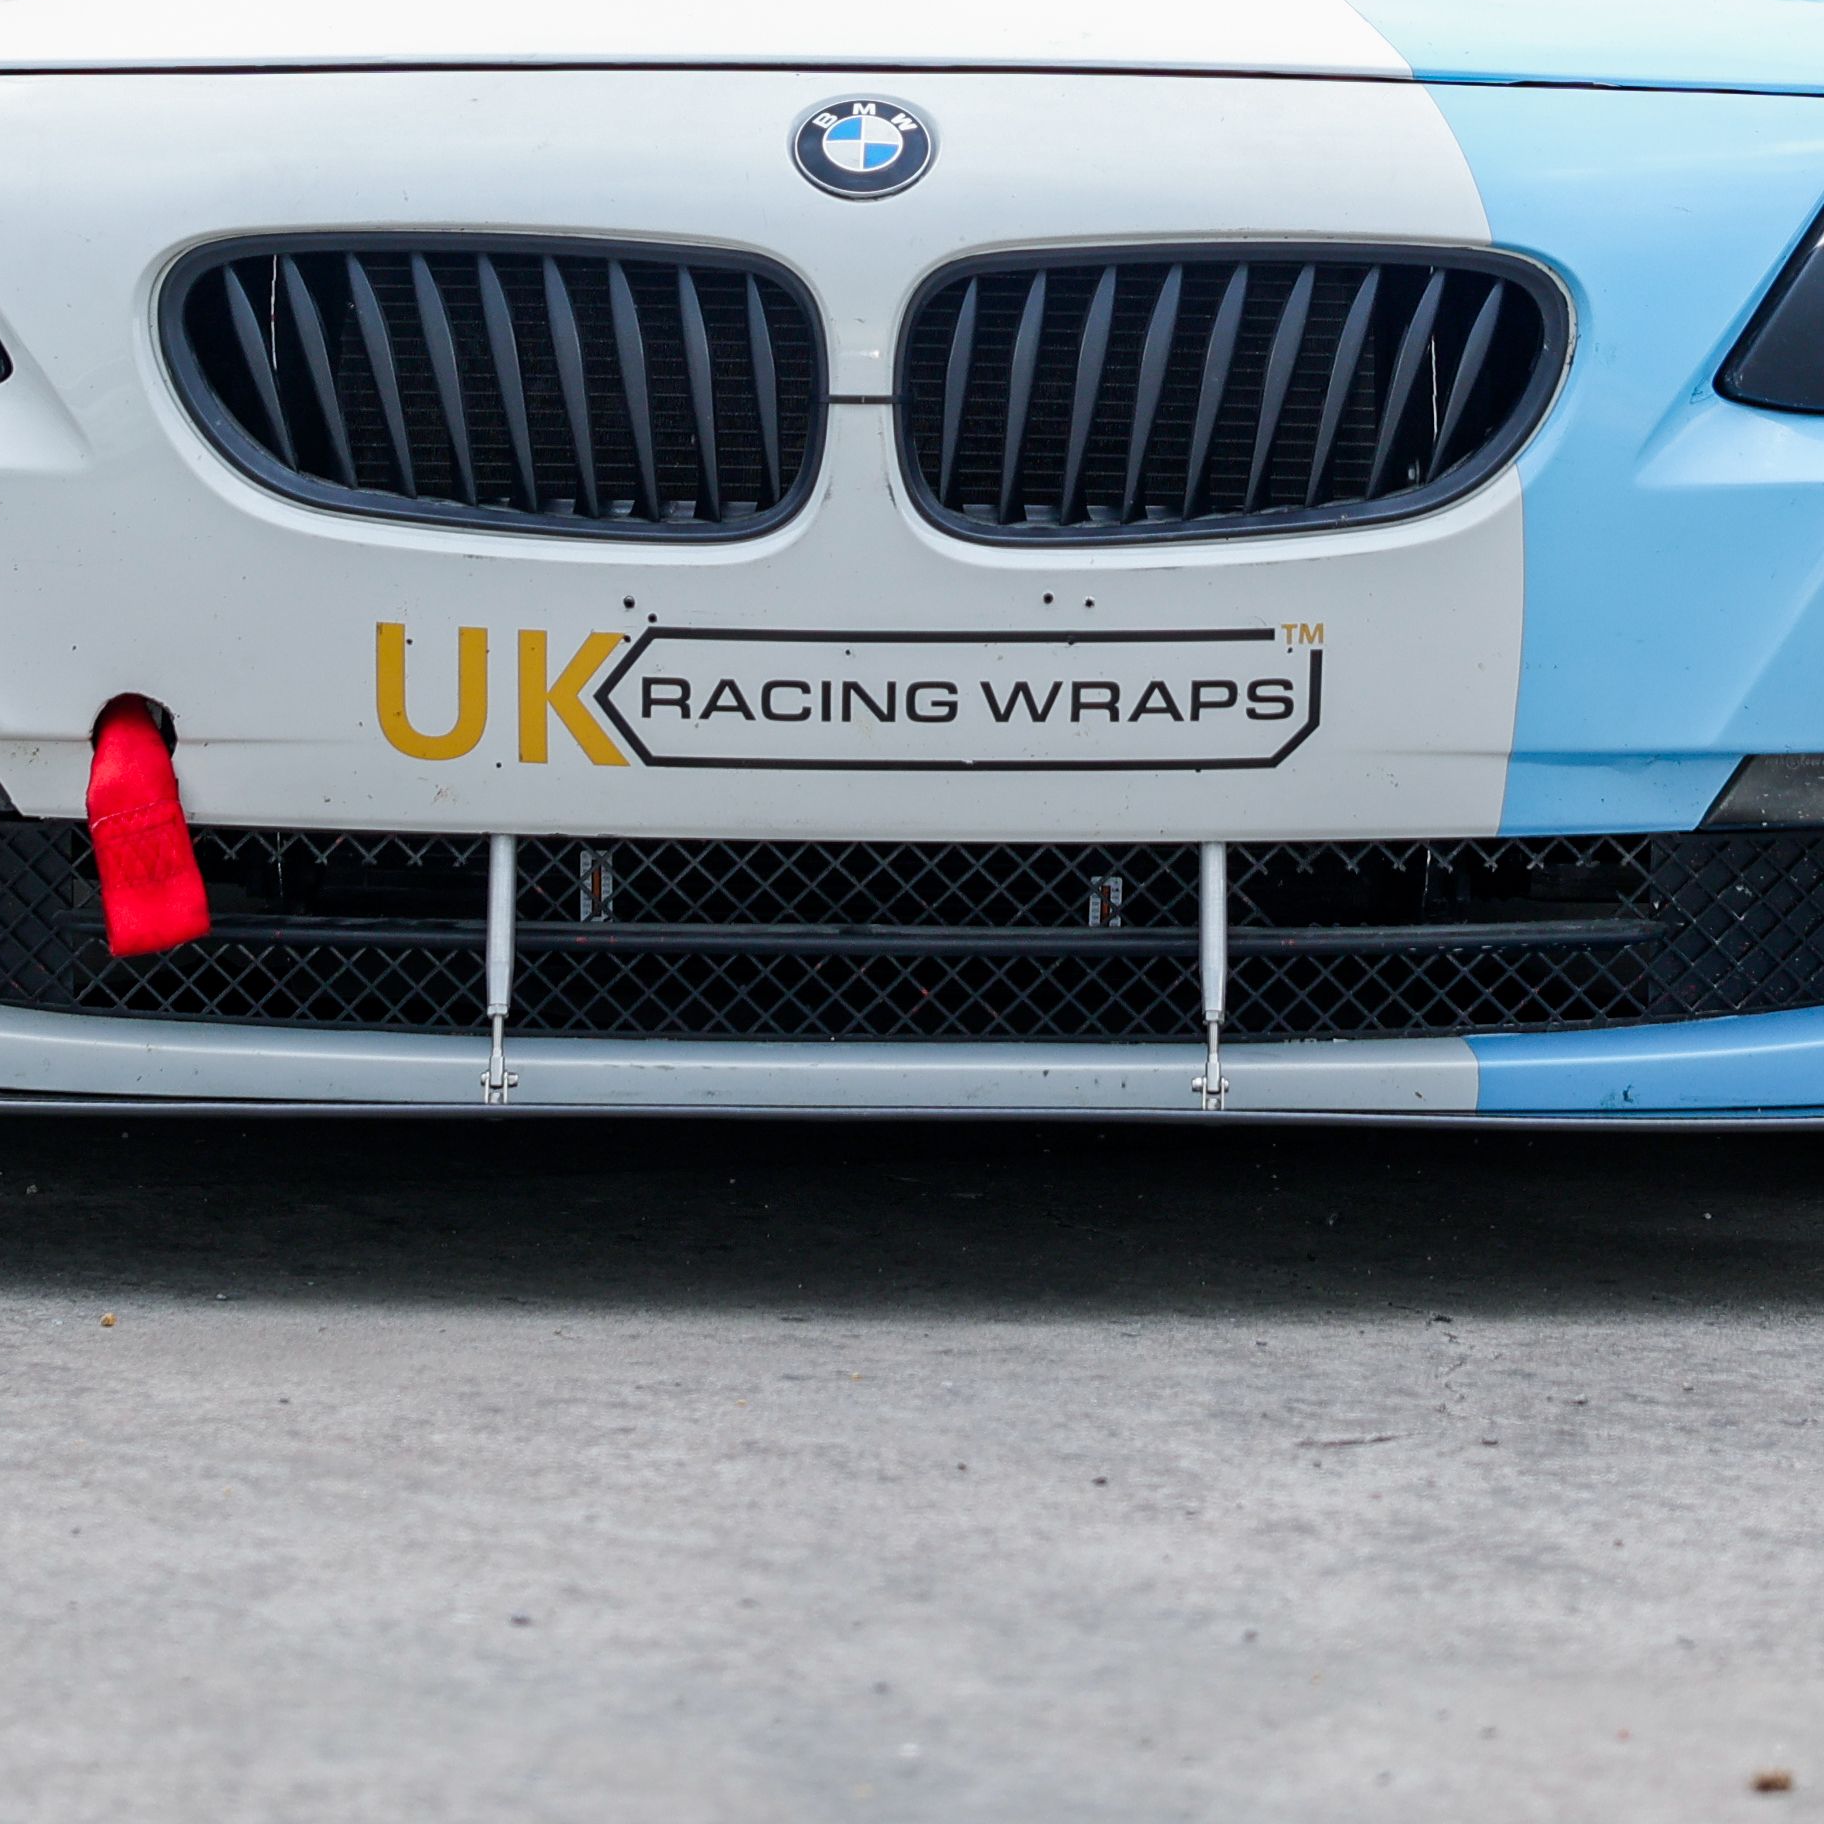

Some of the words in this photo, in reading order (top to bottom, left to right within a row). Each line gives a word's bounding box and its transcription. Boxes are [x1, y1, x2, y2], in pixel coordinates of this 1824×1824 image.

[811, 102, 918, 132] BMW
[375, 622, 631, 765] UK
[641, 677, 959, 724] RACING
[980, 676, 1296, 724] WRAPS
[1281, 623, 1326, 646] TM
